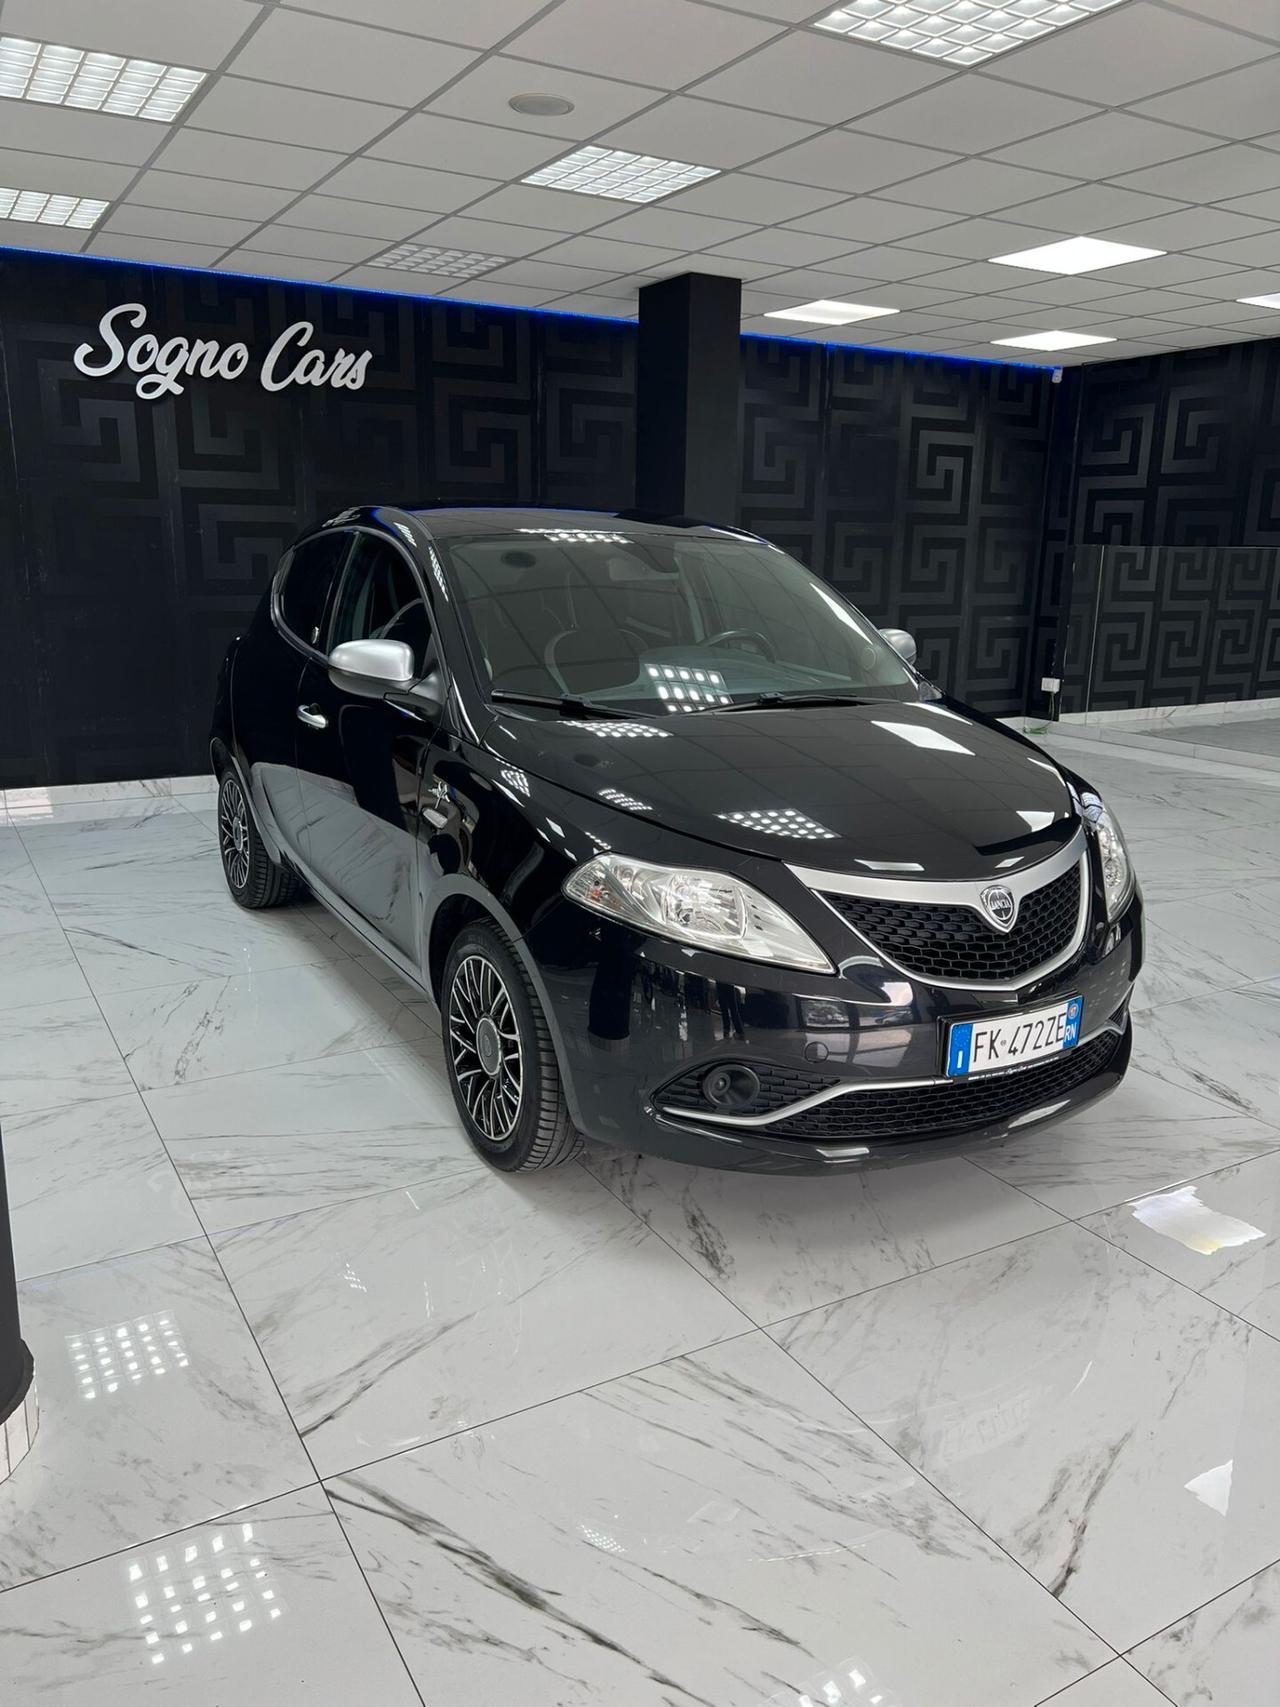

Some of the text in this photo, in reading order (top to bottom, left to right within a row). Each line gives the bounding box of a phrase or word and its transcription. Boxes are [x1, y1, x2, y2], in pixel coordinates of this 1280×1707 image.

[74, 303, 373, 399] Sogno Cars
[973, 1029, 1002, 1062] FK
[1008, 1012, 1067, 1055] 472ZE
[1064, 1022, 1078, 1042] RN
